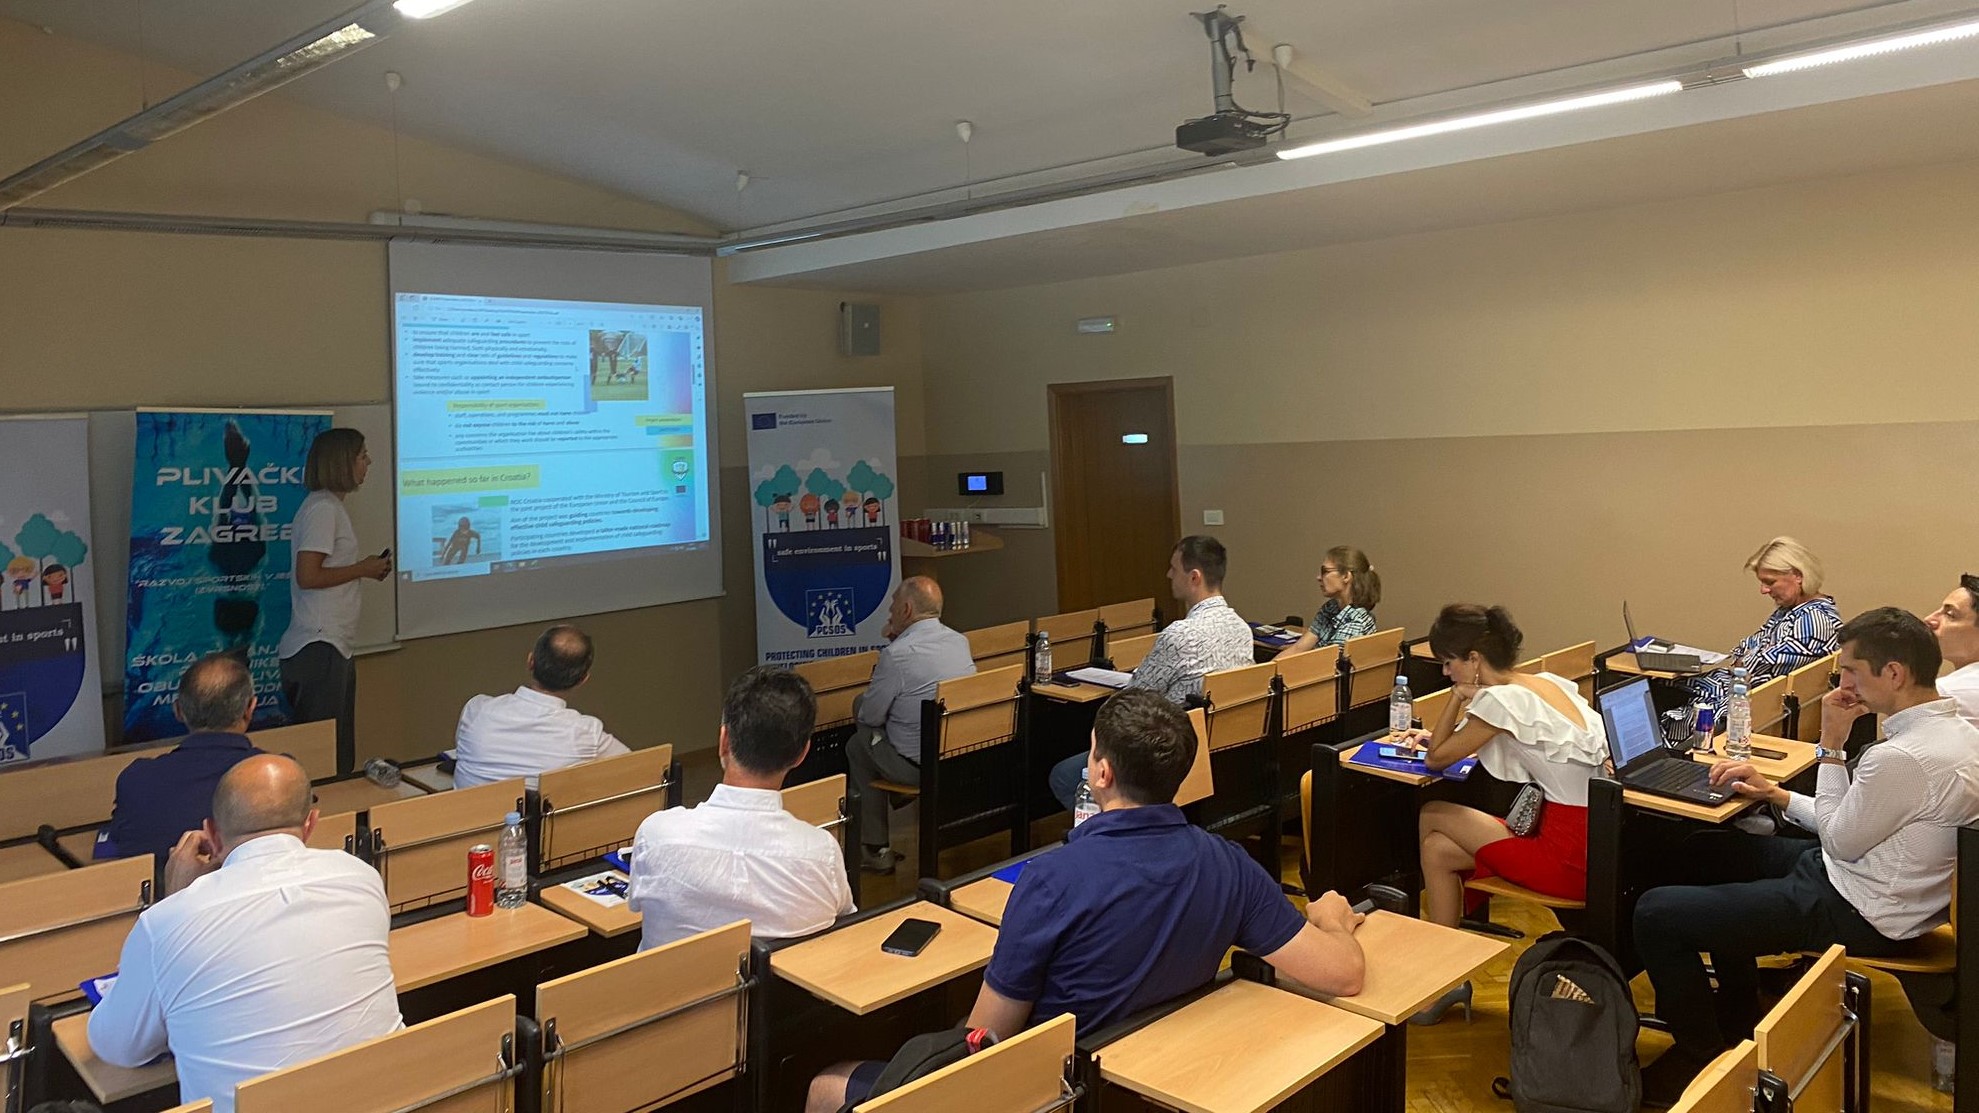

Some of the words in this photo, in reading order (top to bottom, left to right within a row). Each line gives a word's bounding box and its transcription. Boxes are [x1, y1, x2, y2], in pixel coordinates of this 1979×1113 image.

[403, 479, 425, 487] What
[426, 476, 467, 487] happened
[500, 471, 532, 481] Croatia?
[189, 496, 278, 515] KLUB
[794, 546, 843, 555] environment
[854, 544, 878, 552] sports
[12, 633, 23, 641] in
[27, 627, 64, 641] sports
[816, 624, 847, 635] PCSOS
[765, 649, 815, 661] PROTECTING
[817, 646, 857, 658] CHILDREN
